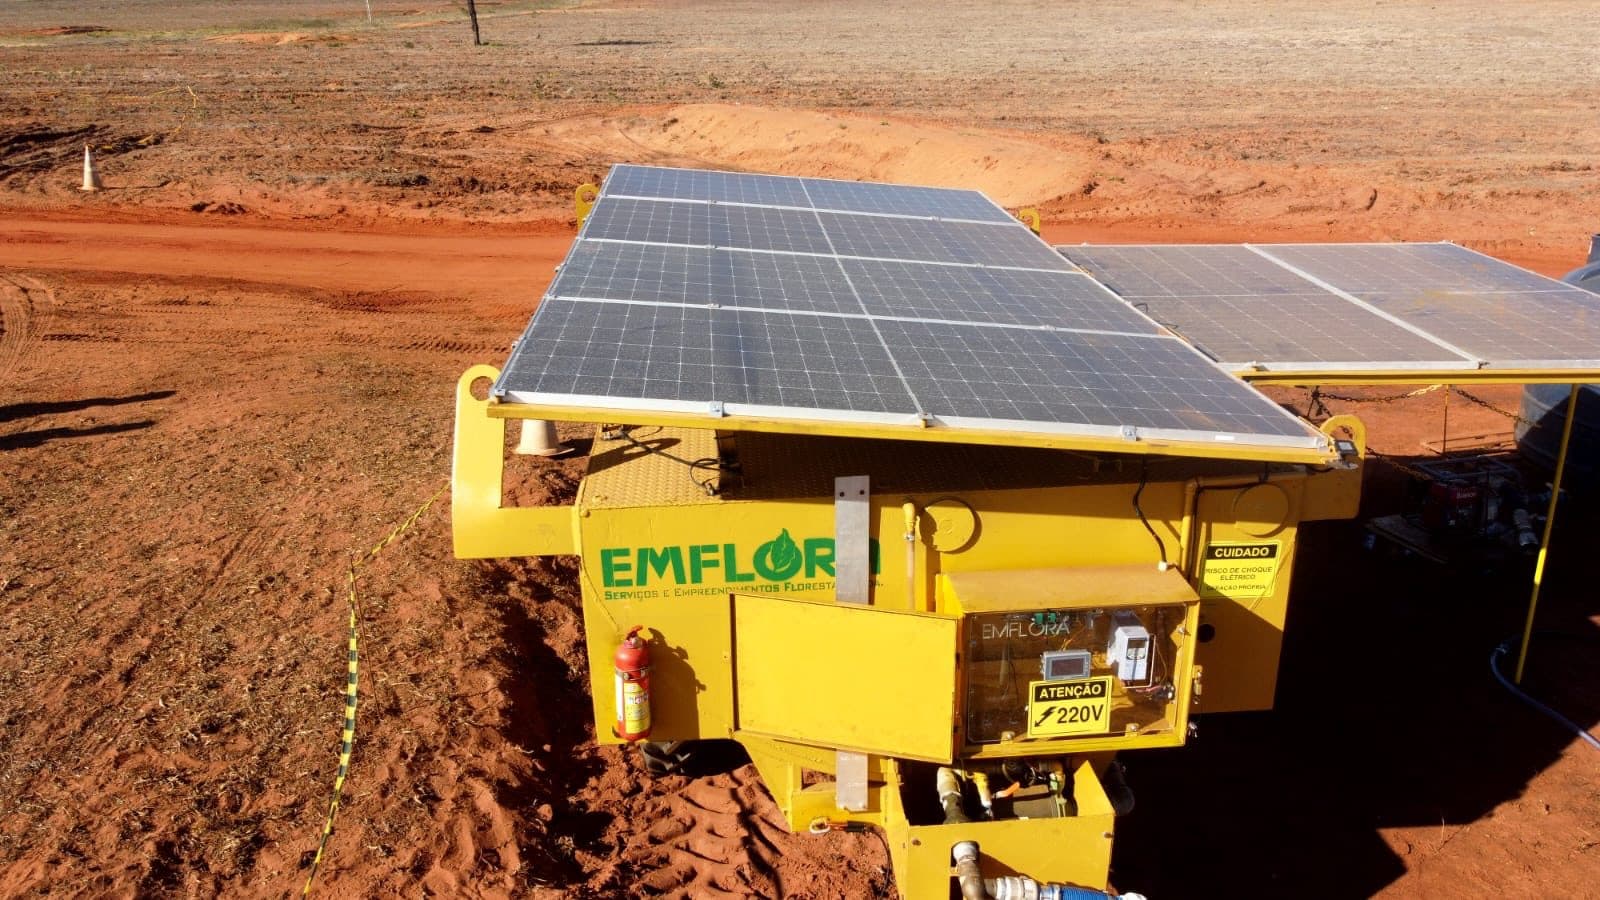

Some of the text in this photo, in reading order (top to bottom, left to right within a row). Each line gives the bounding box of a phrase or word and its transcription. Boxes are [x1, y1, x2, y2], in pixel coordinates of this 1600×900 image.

[600, 530, 881, 587] EMFLOR
[1214, 547, 1270, 558] CUIDADO
[785, 581, 838, 592] FLORESTA
[982, 620, 1071, 640] EMFLORA
[1039, 682, 1102, 700] ATENÇÃO
[1056, 704, 1105, 724] 220V
